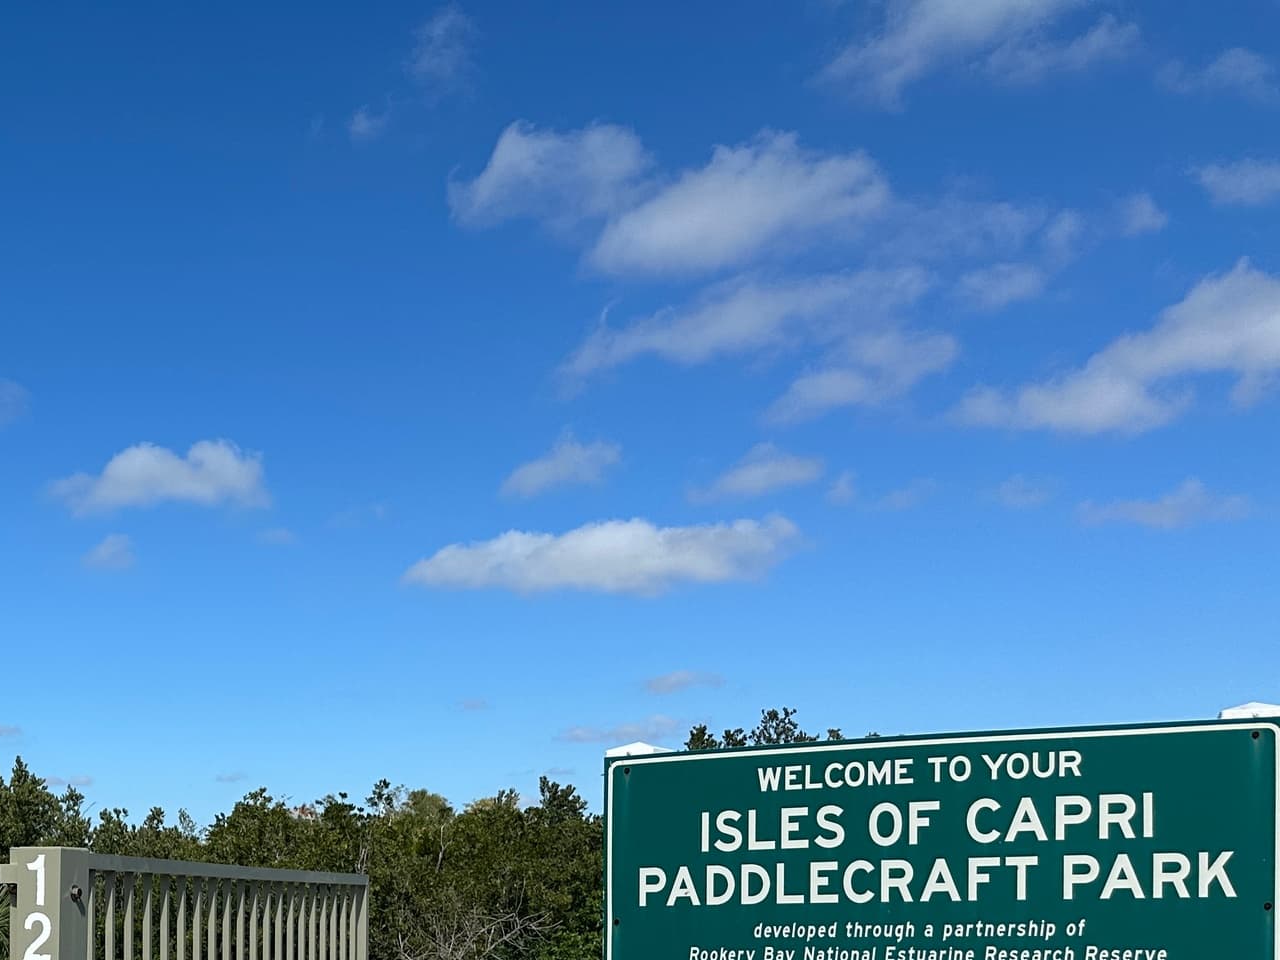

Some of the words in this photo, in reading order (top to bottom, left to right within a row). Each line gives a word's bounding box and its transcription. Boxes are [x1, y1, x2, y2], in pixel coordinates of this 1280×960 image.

[758, 759, 913, 791] WELCOME
[928, 756, 971, 782] TO
[981, 751, 1081, 780] YOUR
[702, 805, 845, 852] ISLES
[869, 801, 940, 846] OF
[967, 792, 1153, 843] CAPRI
[639, 856, 1038, 906] PADDLECRAFT
[1063, 851, 1237, 899] PARK
[754, 922, 837, 942] developed
[846, 921, 914, 942] through
[924, 925, 933, 937] a
[943, 920, 1056, 941] partnership
[1066, 919, 1085, 936] of
